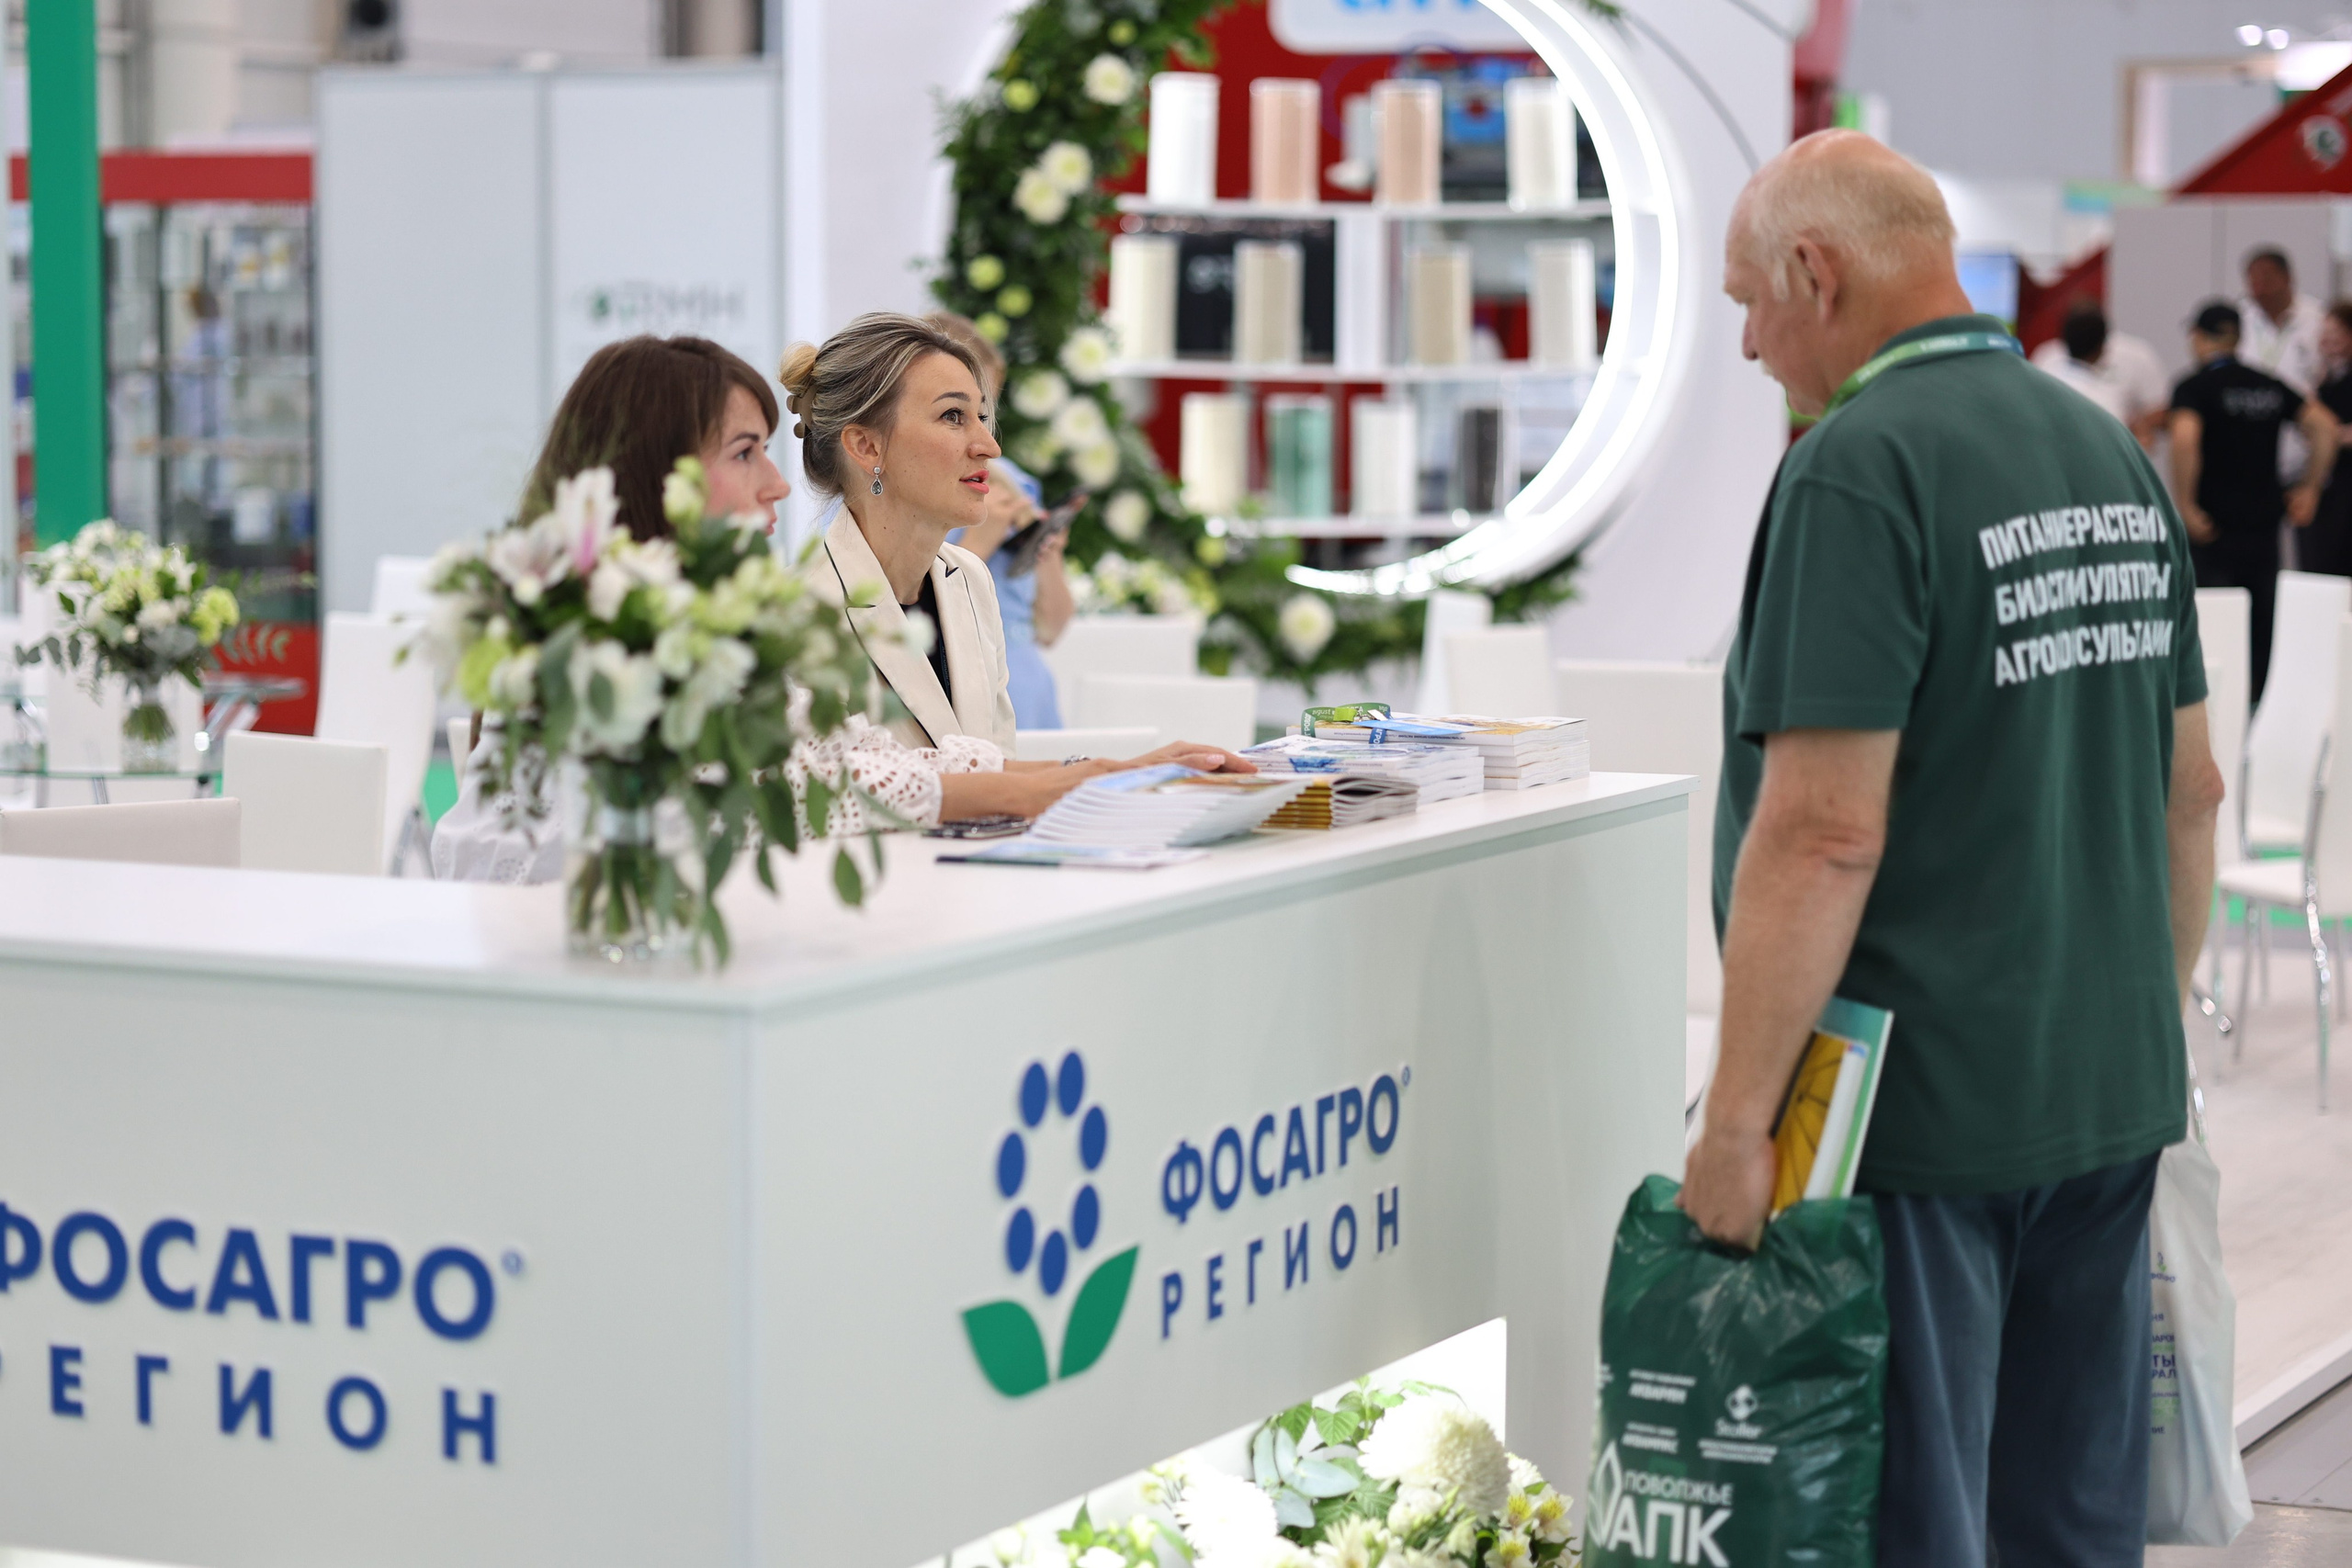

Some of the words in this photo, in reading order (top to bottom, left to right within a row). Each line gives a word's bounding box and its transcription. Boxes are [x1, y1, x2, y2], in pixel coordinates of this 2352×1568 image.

[1161, 1074, 1400, 1224] ФОСАГРО
[1161, 1185, 1399, 1340] РЕГИОН
[0, 1342, 499, 1468] ЕГИОН
[1607, 1495, 1734, 1568] АПК
[1623, 1470, 1735, 1506] ПОВОЛЖЬЕ
